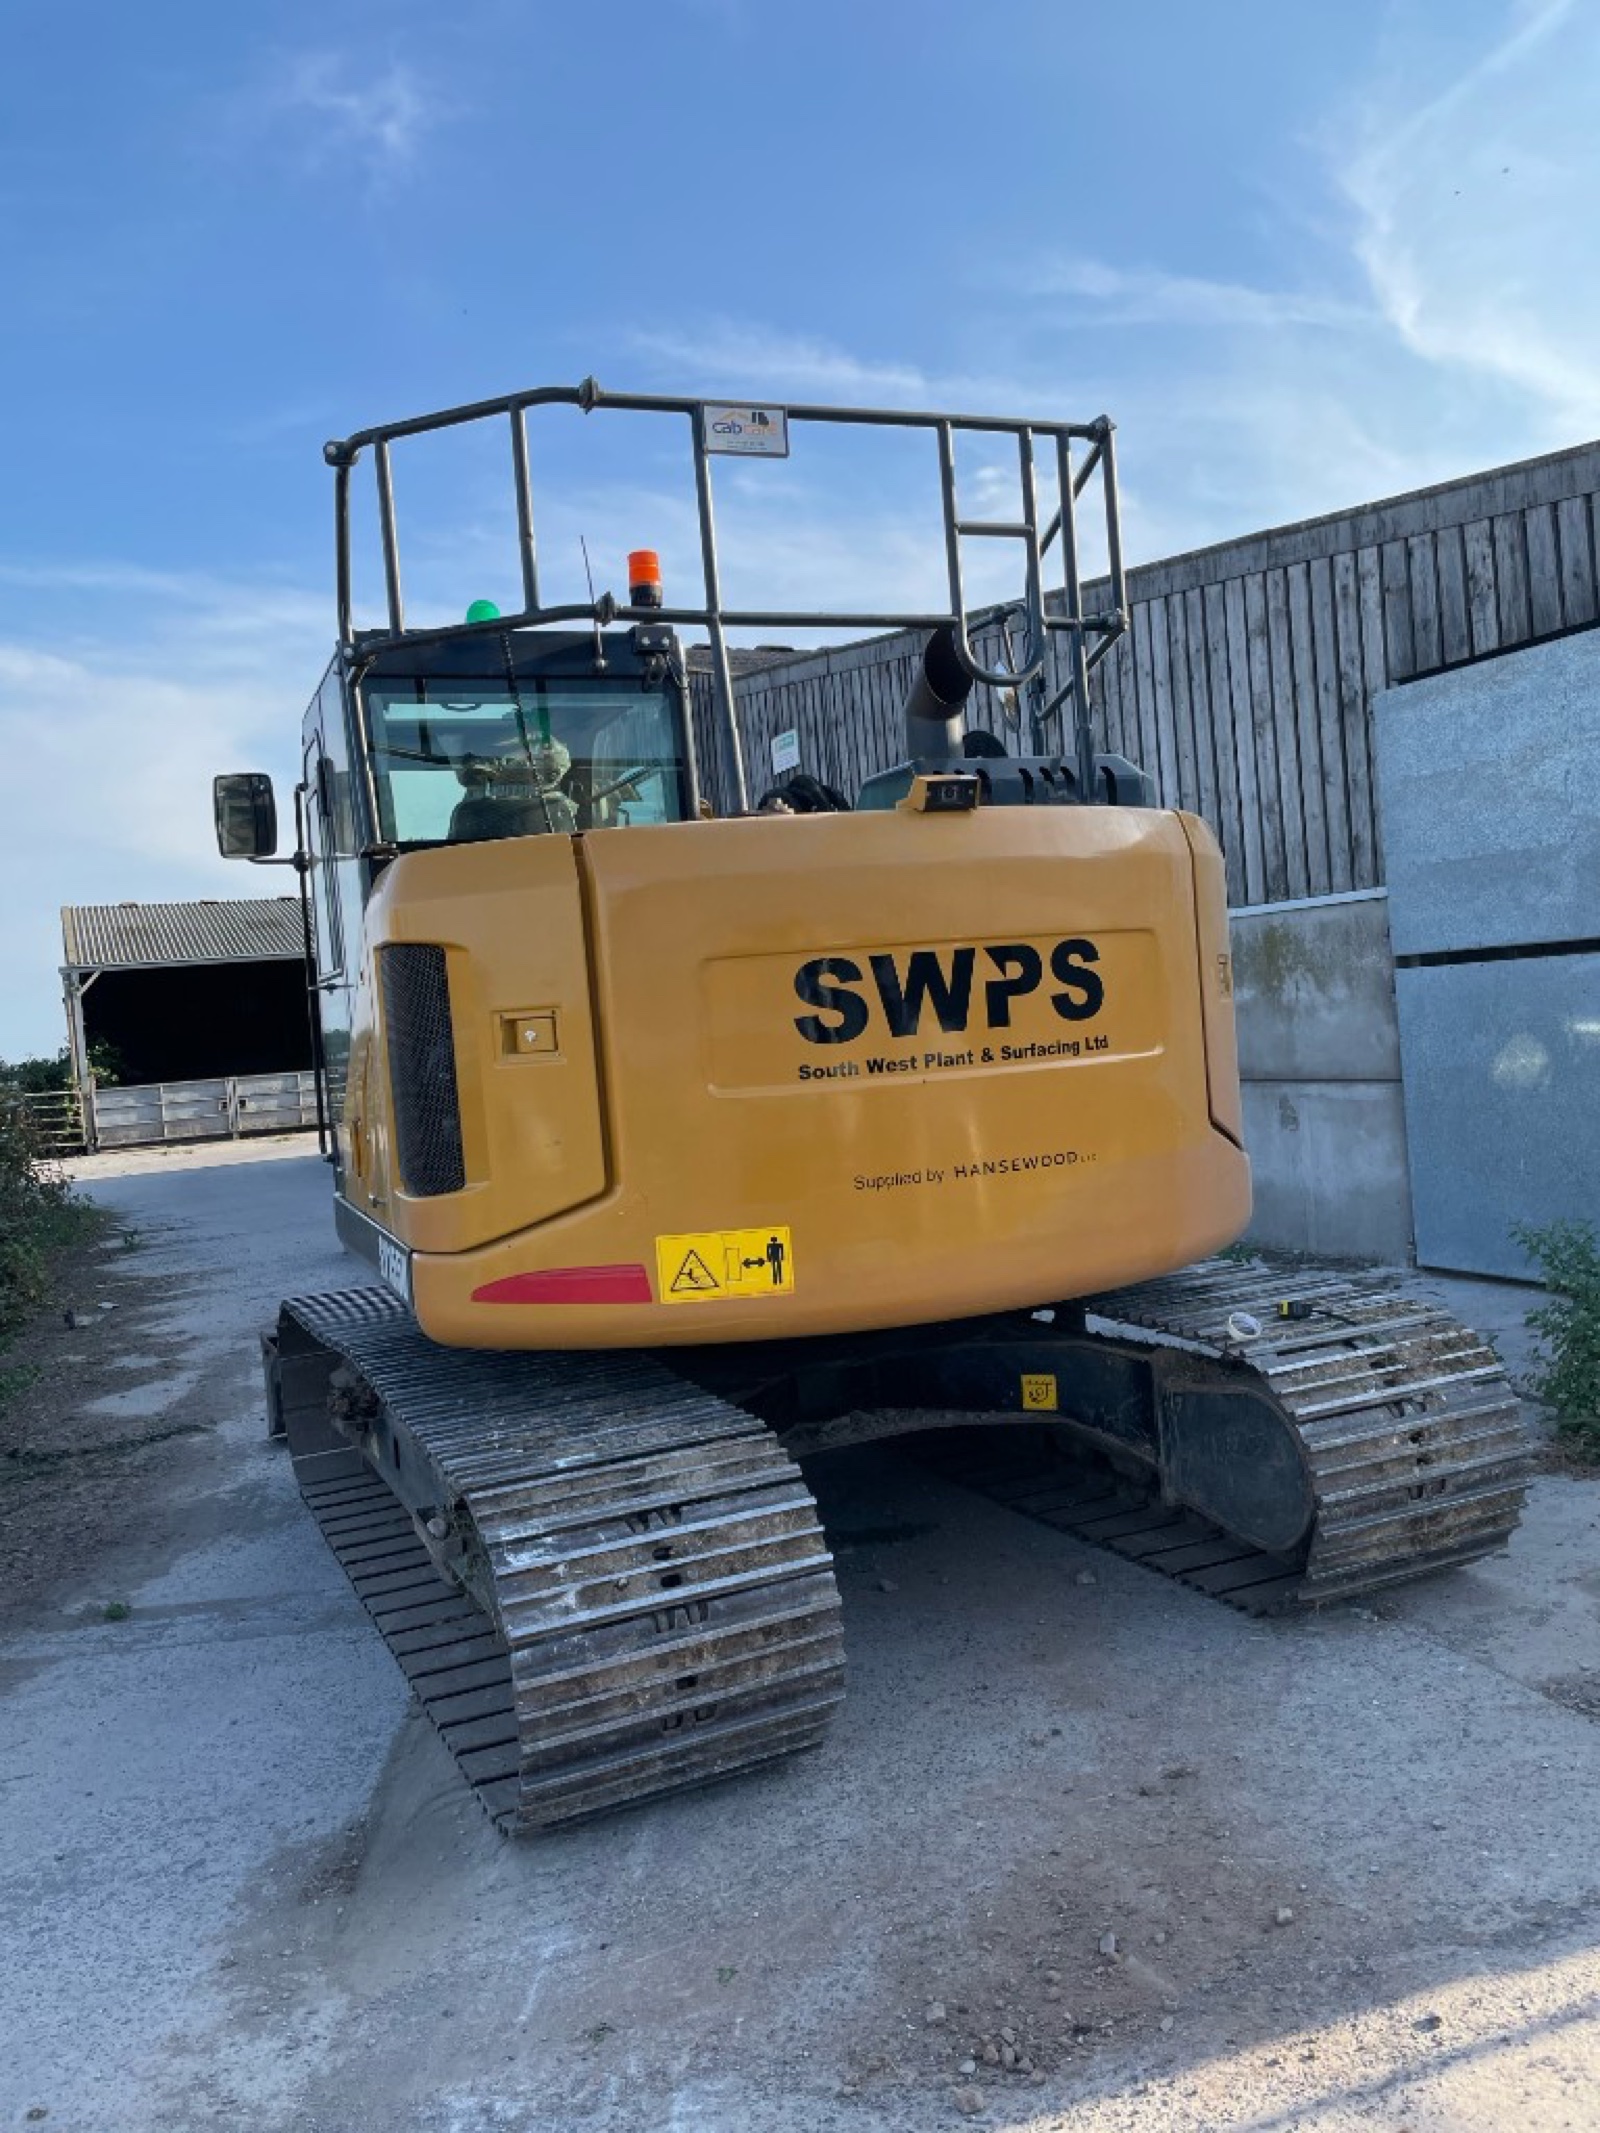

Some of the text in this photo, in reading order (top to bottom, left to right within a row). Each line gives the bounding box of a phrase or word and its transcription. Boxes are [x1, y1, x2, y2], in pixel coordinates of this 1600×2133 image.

[793, 938, 1104, 1044] SWPS
[799, 1034, 1108, 1080] South West Plant & Surfacing Ltd
[853, 1170, 921, 1192] Supplied
[926, 1167, 944, 1183] by
[953, 1151, 1077, 1179] HANSEWOOD
